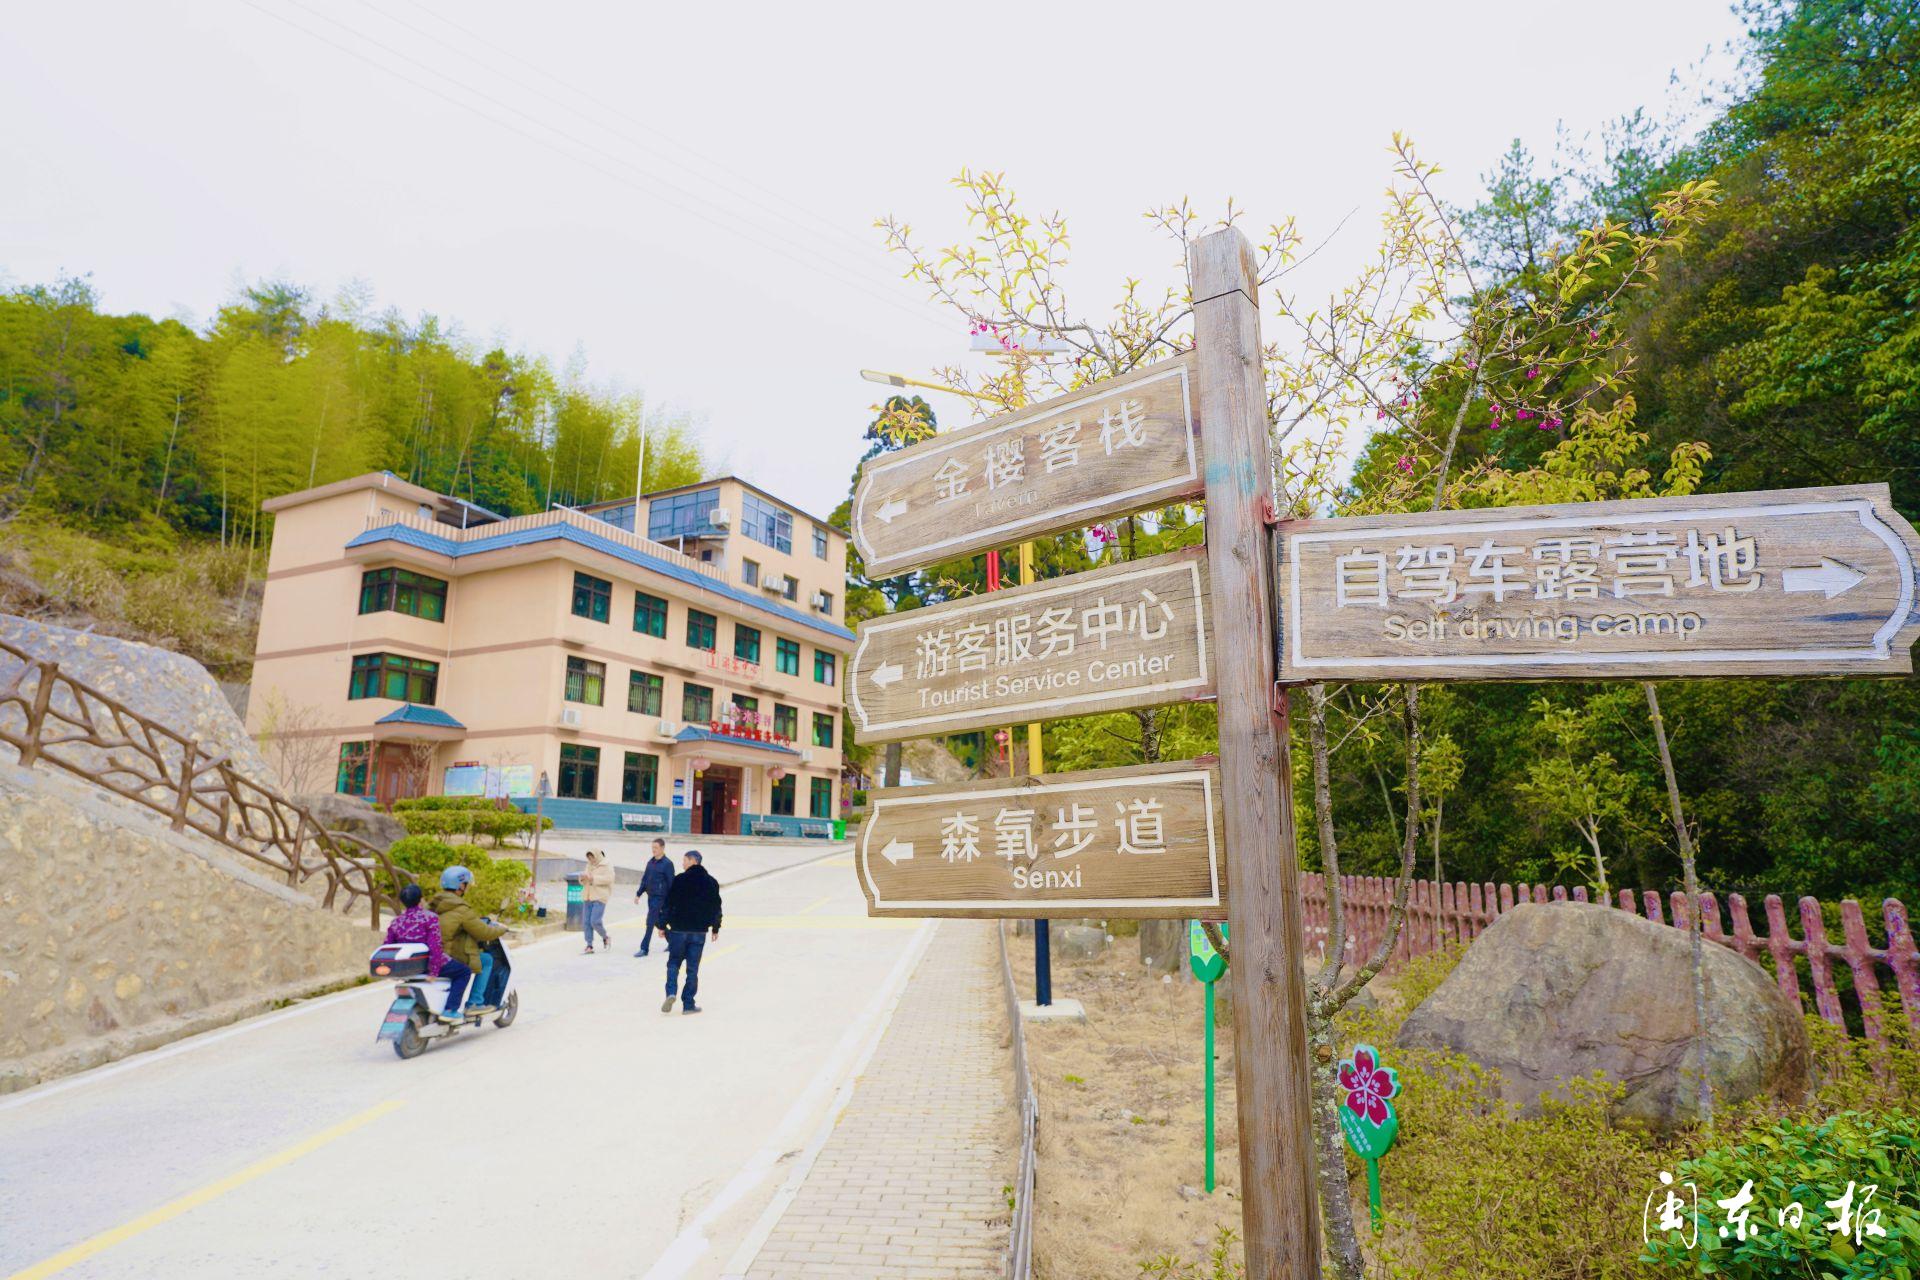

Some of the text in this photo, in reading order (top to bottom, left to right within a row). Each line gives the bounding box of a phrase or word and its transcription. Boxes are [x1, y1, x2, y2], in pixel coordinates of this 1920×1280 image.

[933, 399, 1148, 505] 金樱客栈
[1335, 526, 1763, 609] 自驾车露营地
[915, 588, 1175, 680] 游客服务中心
[1384, 608, 1703, 643] Self driving camp
[918, 652, 1174, 709] Tourist Service Center
[940, 798, 1166, 863] 森氧步道
[1013, 864, 1082, 889] Senxi
